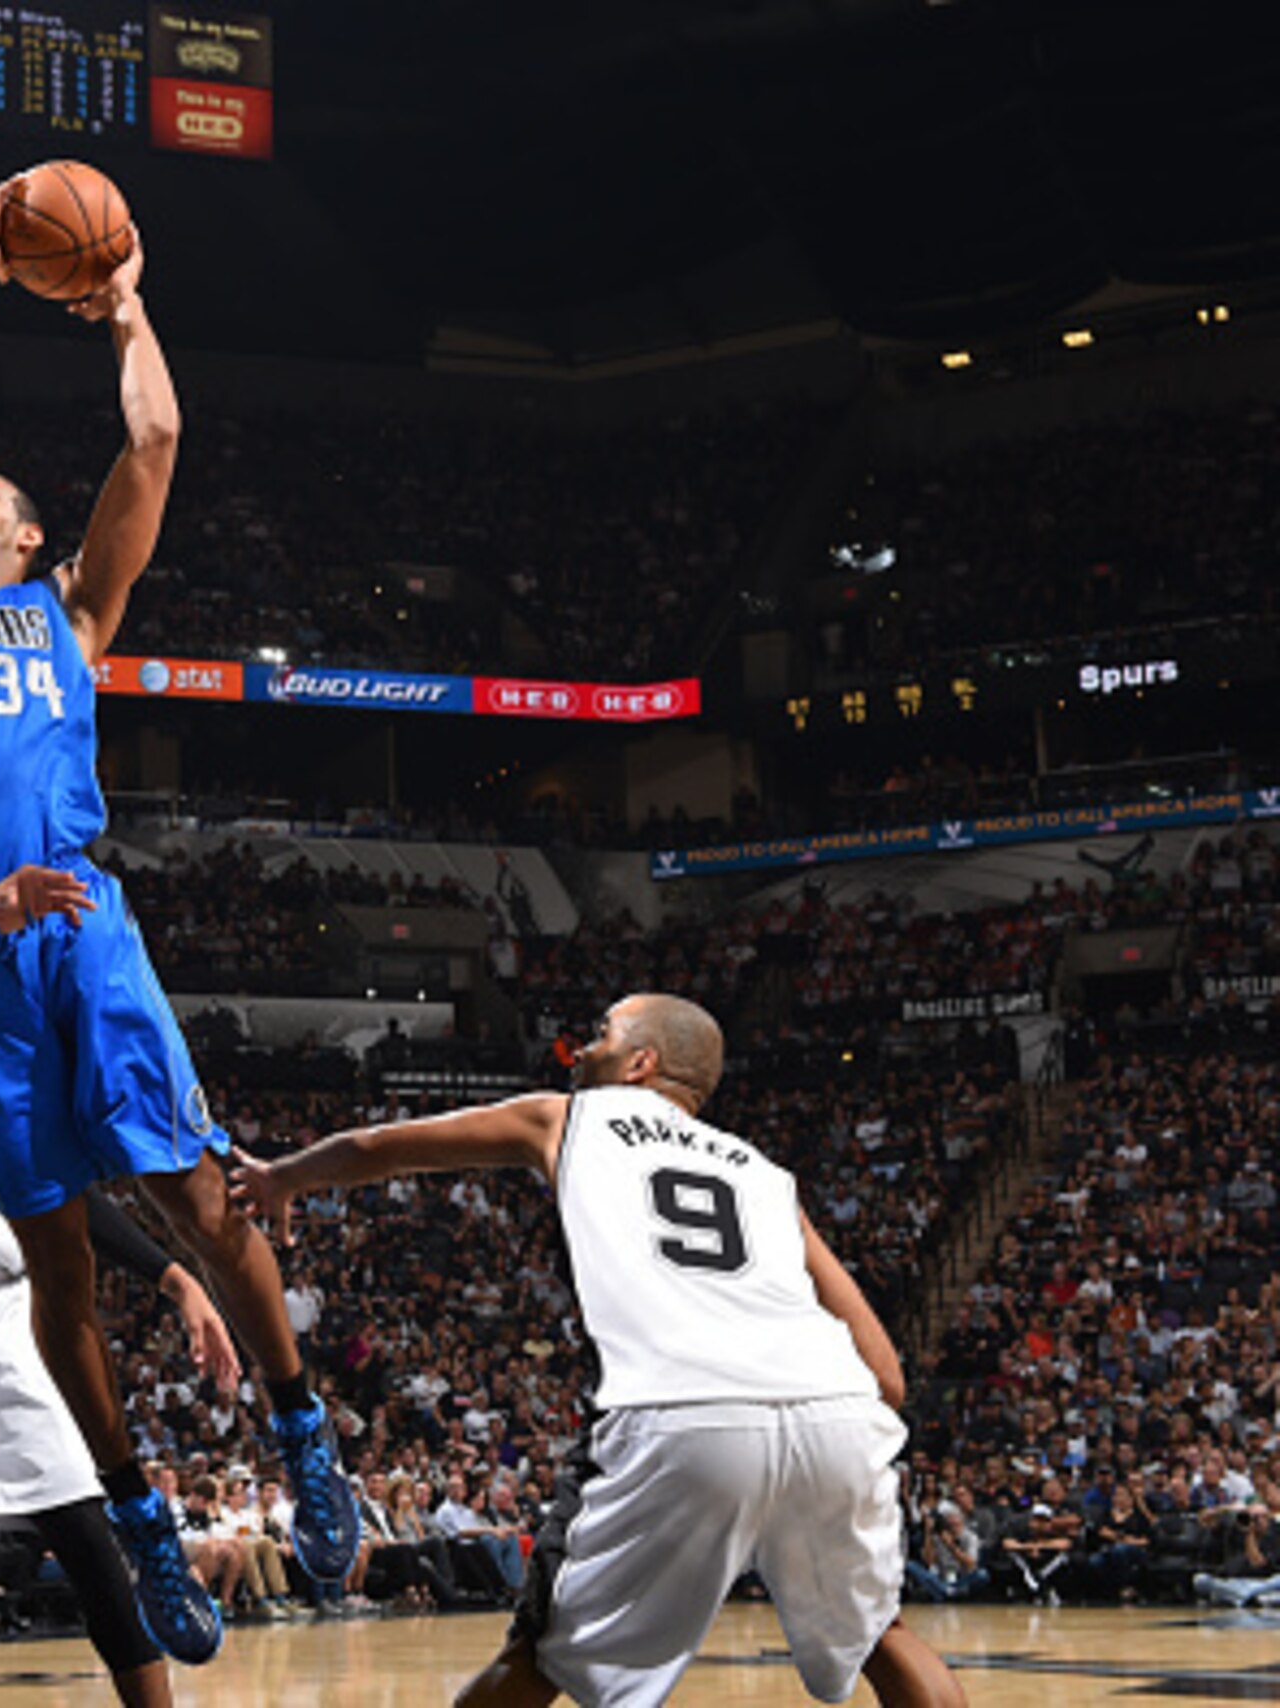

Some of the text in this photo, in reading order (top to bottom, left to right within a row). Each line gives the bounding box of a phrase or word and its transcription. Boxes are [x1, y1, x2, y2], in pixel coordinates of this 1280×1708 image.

[1080, 660, 1178, 694] Spurs
[607, 1112, 751, 1169] PARKER
[647, 1166, 751, 1274] 9
